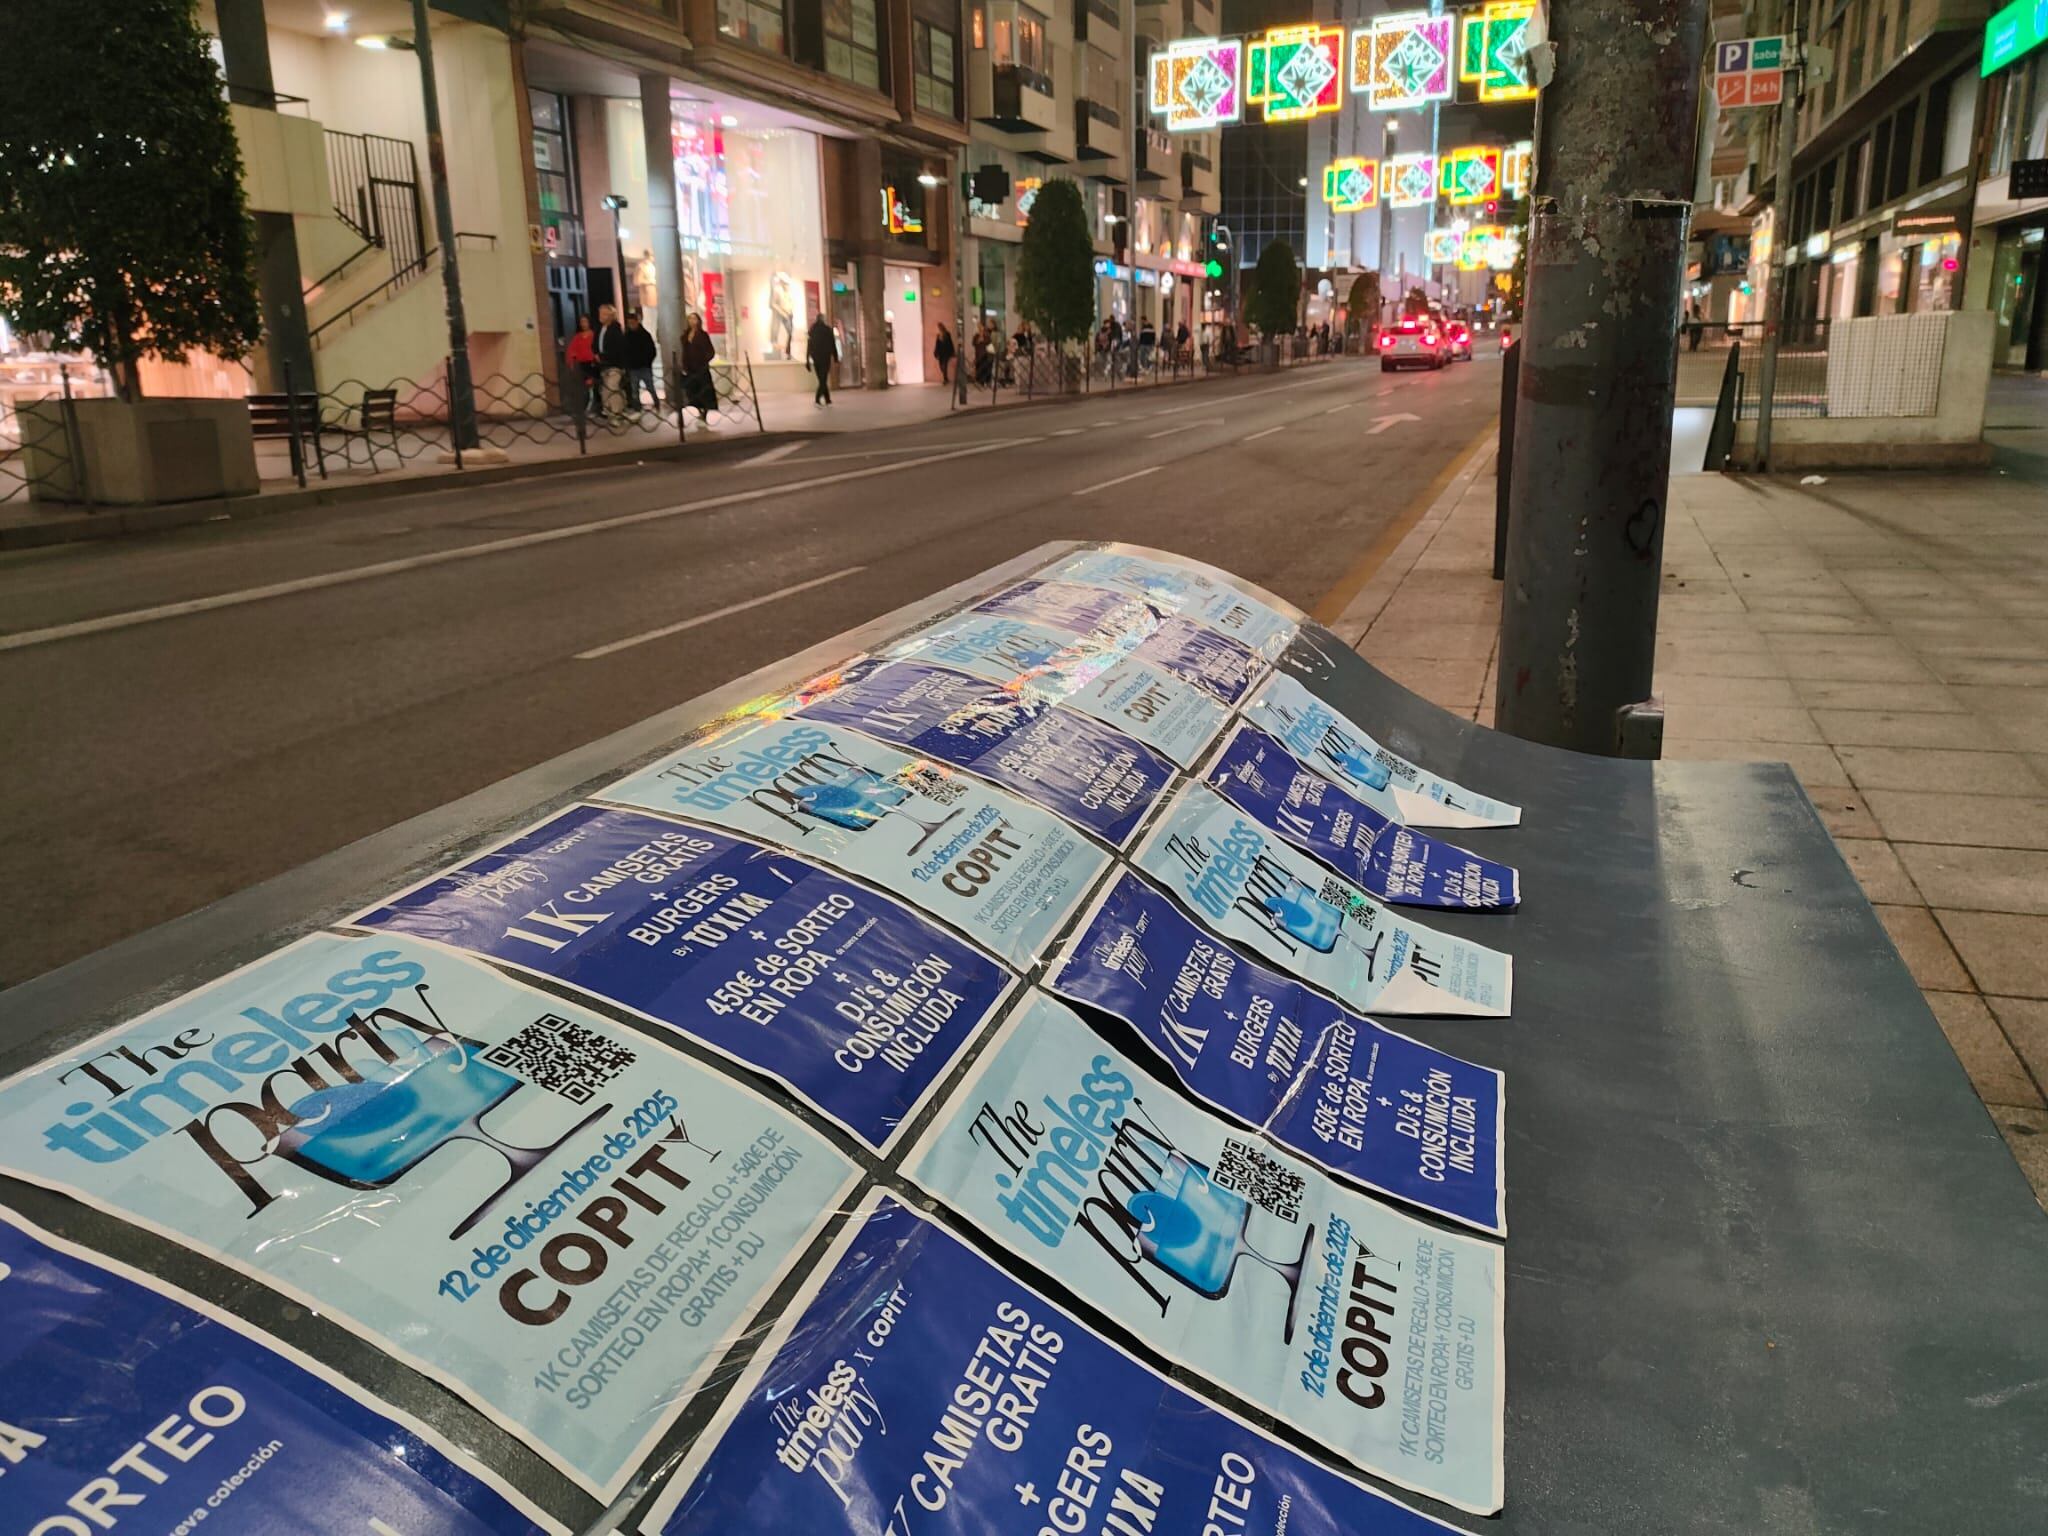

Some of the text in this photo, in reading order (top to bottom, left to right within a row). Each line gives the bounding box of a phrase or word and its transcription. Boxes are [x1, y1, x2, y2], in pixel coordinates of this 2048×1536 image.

[1725, 45, 1742, 70] P
[657, 754, 733, 786] The
[672, 727, 832, 811] timeless
[741, 742, 884, 836] party
[1106, 769, 1149, 813] INCLUIDA
[481, 864, 549, 906] party
[501, 832, 689, 954] 1K CAMISETAS
[634, 839, 715, 884] GRATIS
[911, 868, 932, 883] 12
[933, 830, 976, 865] diciembre
[1165, 833, 1211, 877] The
[1185, 820, 1264, 919] timeless
[627, 873, 740, 946] BURGERS
[1232, 845, 1317, 957] party
[672, 944, 694, 957] By
[705, 894, 855, 1016] 450€ de SORTEO
[739, 992, 786, 1025] EN
[769, 949, 837, 999] ROPA
[1202, 952, 1236, 1000] GRATIS
[834, 952, 953, 1074] CONSUMICIÓN
[835, 968, 901, 1022] DJ's &
[879, 988, 965, 1073] INCLUIDA
[1160, 939, 1214, 1071] 1K CAMISETAS
[1230, 995, 1275, 1070] BURGERS
[42, 950, 427, 1164] timeless
[57, 1028, 215, 1102] The
[1311, 1020, 1356, 1143] 450€ de SORTEO
[173, 984, 478, 1220] party
[968, 1100, 1046, 1178] The
[1338, 1120, 1365, 1152] EN
[1343, 1077, 1372, 1125] ROPA
[1395, 1089, 1424, 1139] DJ's &
[1419, 1068, 1452, 1182] CONSUMICIÓN
[1449, 1096, 1476, 1174] INCLUIDA
[995, 1055, 1134, 1248] timeless
[438, 1089, 679, 1304] 12 de diciembre de 2025
[1074, 1098, 1210, 1318] party
[534, 1362, 571, 1394] 1K
[558, 1266, 658, 1369] CAMISETAS
[645, 1242, 676, 1275] DE
[671, 1183, 733, 1257] REGALO
[736, 1146, 769, 1182] 540€
[760, 1127, 785, 1153] DE
[679, 1264, 739, 1329] GRATIS
[738, 1231, 765, 1261] DJ
[1418, 1238, 1434, 1257] DE
[1300, 1213, 1351, 1399] 12 de diciembre de 2025
[1411, 1285, 1432, 1345] REGALO
[1458, 1316, 1476, 1334] DJ
[566, 1327, 646, 1411] SORTEO
[640, 1300, 670, 1333] EN
[985, 1323, 1064, 1452] GRATIS
[1408, 1342, 1426, 1362] DE
[1431, 1376, 1448, 1403] EN
[1455, 1339, 1475, 1391] GRATIS
[769, 1397, 805, 1438] The
[775, 1359, 857, 1473] timeless
[910, 1301, 1031, 1512] CAMISETAS
[1402, 1356, 1426, 1436] CAMISETAS
[1424, 1397, 1448, 1465] SORTEO
[207, 1438, 283, 1508] colección
[809, 1377, 887, 1511] party
[1400, 1432, 1419, 1458] 1K
